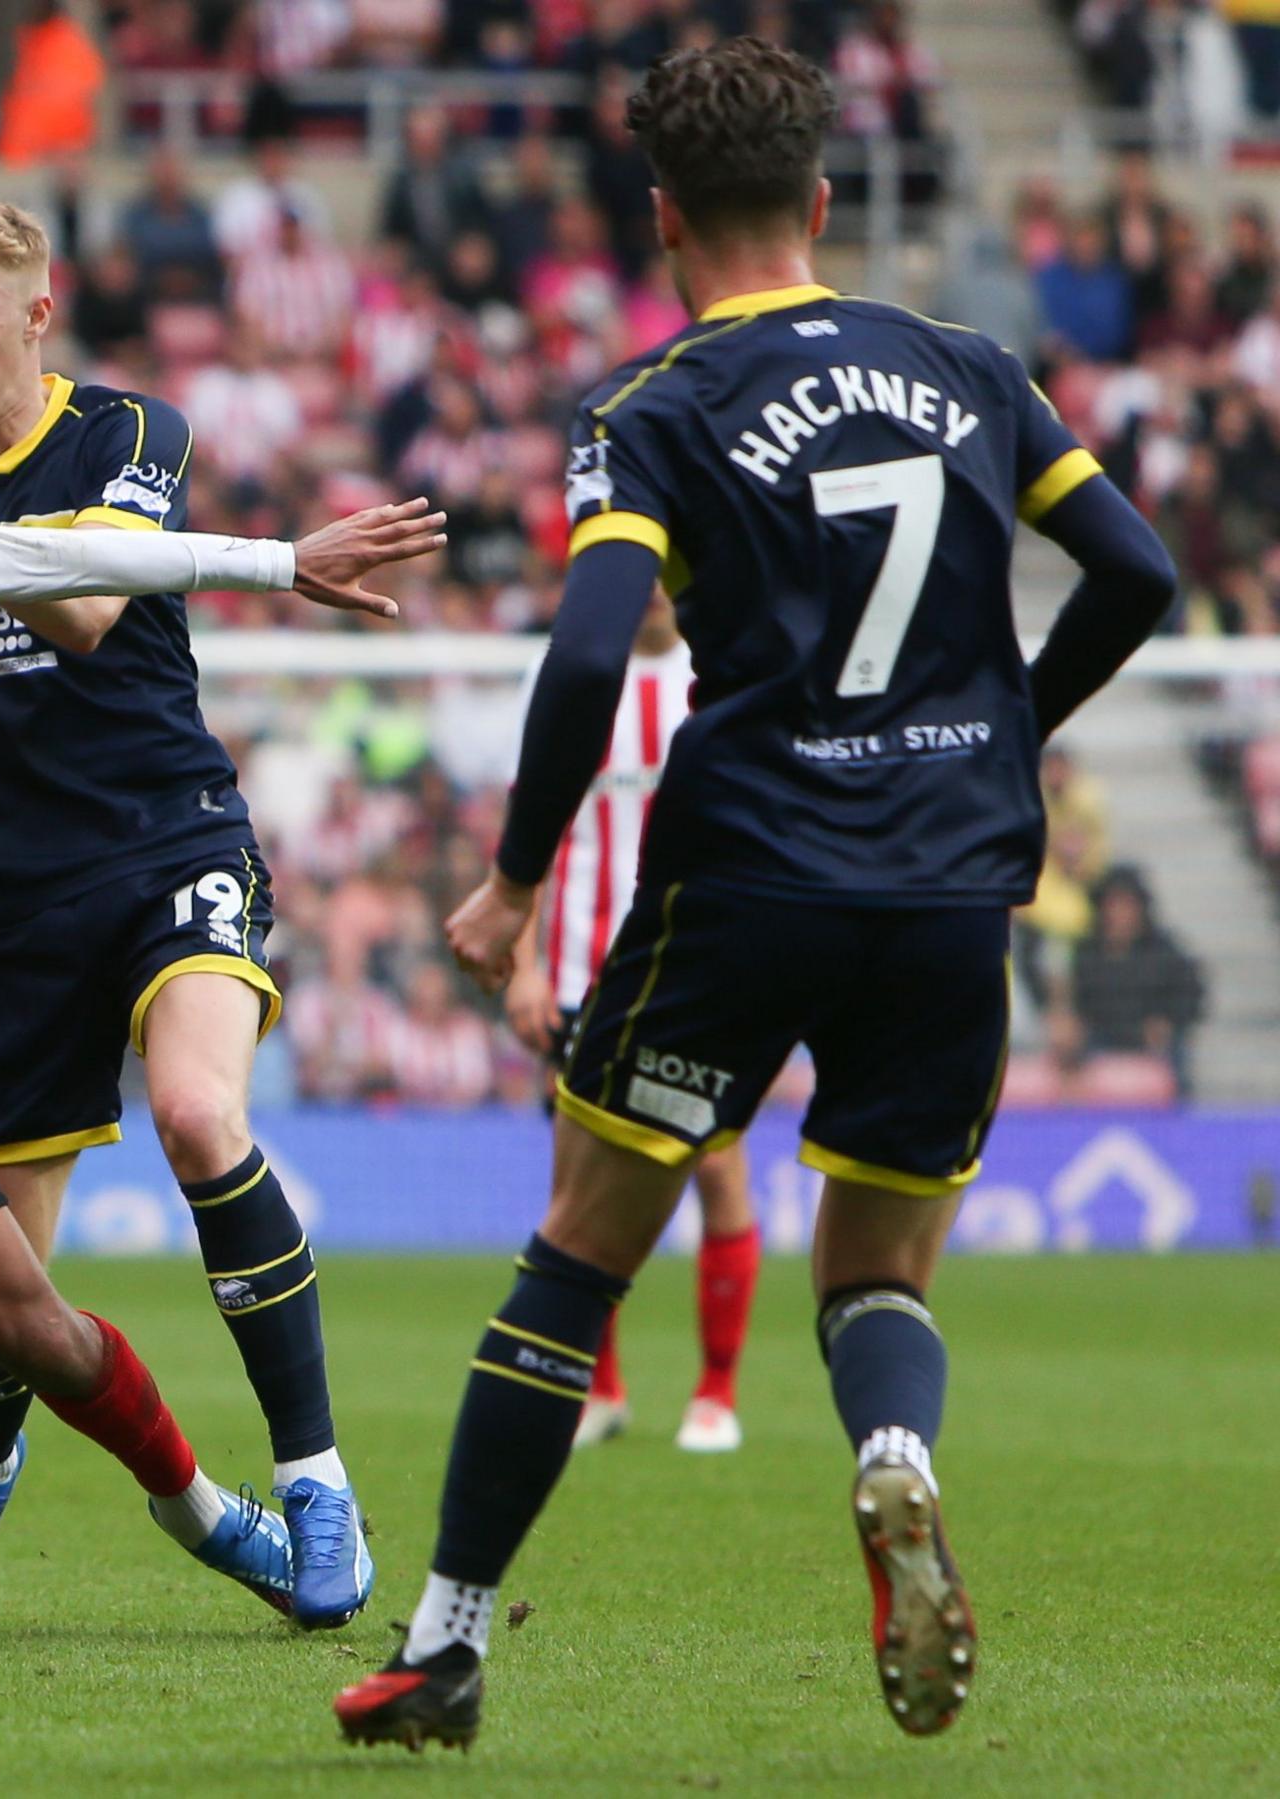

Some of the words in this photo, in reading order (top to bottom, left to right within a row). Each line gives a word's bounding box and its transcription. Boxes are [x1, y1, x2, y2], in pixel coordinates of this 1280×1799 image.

[728, 365, 979, 485] HACKNEY
[808, 454, 945, 698] 7
[169, 871, 243, 928] 19
[636, 1045, 736, 1099] BOXT
